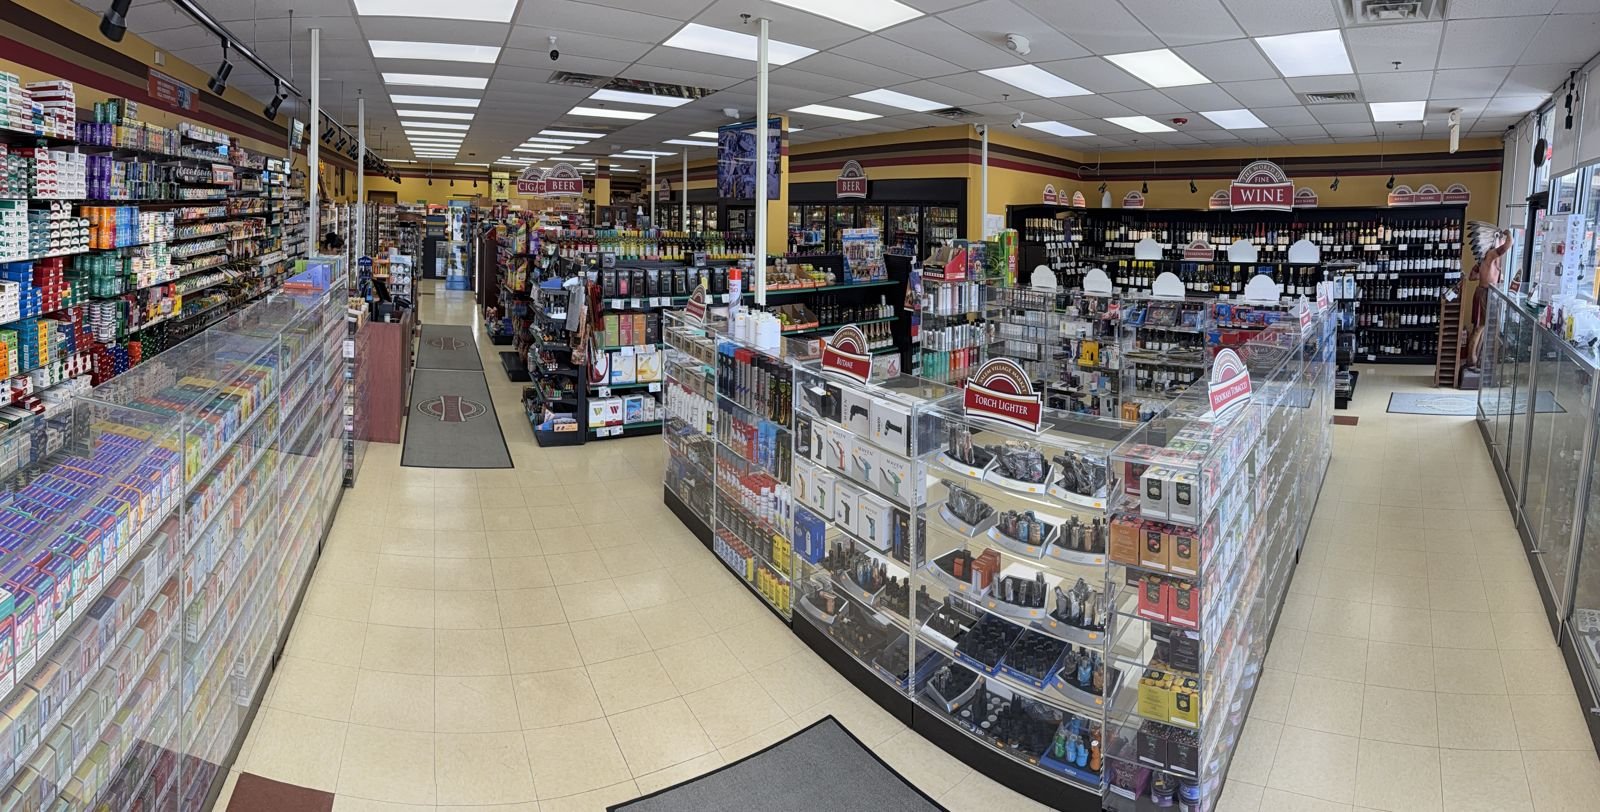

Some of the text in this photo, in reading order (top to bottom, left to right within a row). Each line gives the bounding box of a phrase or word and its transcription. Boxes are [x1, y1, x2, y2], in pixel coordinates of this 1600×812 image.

[1242, 164, 1283, 180] THE WORLD OF
[552, 181, 575, 190] BEER
[842, 181, 861, 191] BEER
[1240, 188, 1284, 202] WINE
[836, 357, 853, 368] BUTANE
[991, 365, 1012, 374] VILLAGE
[1011, 370, 1027, 392] MARKET
[974, 394, 1028, 415] TORCH LIGHTER
